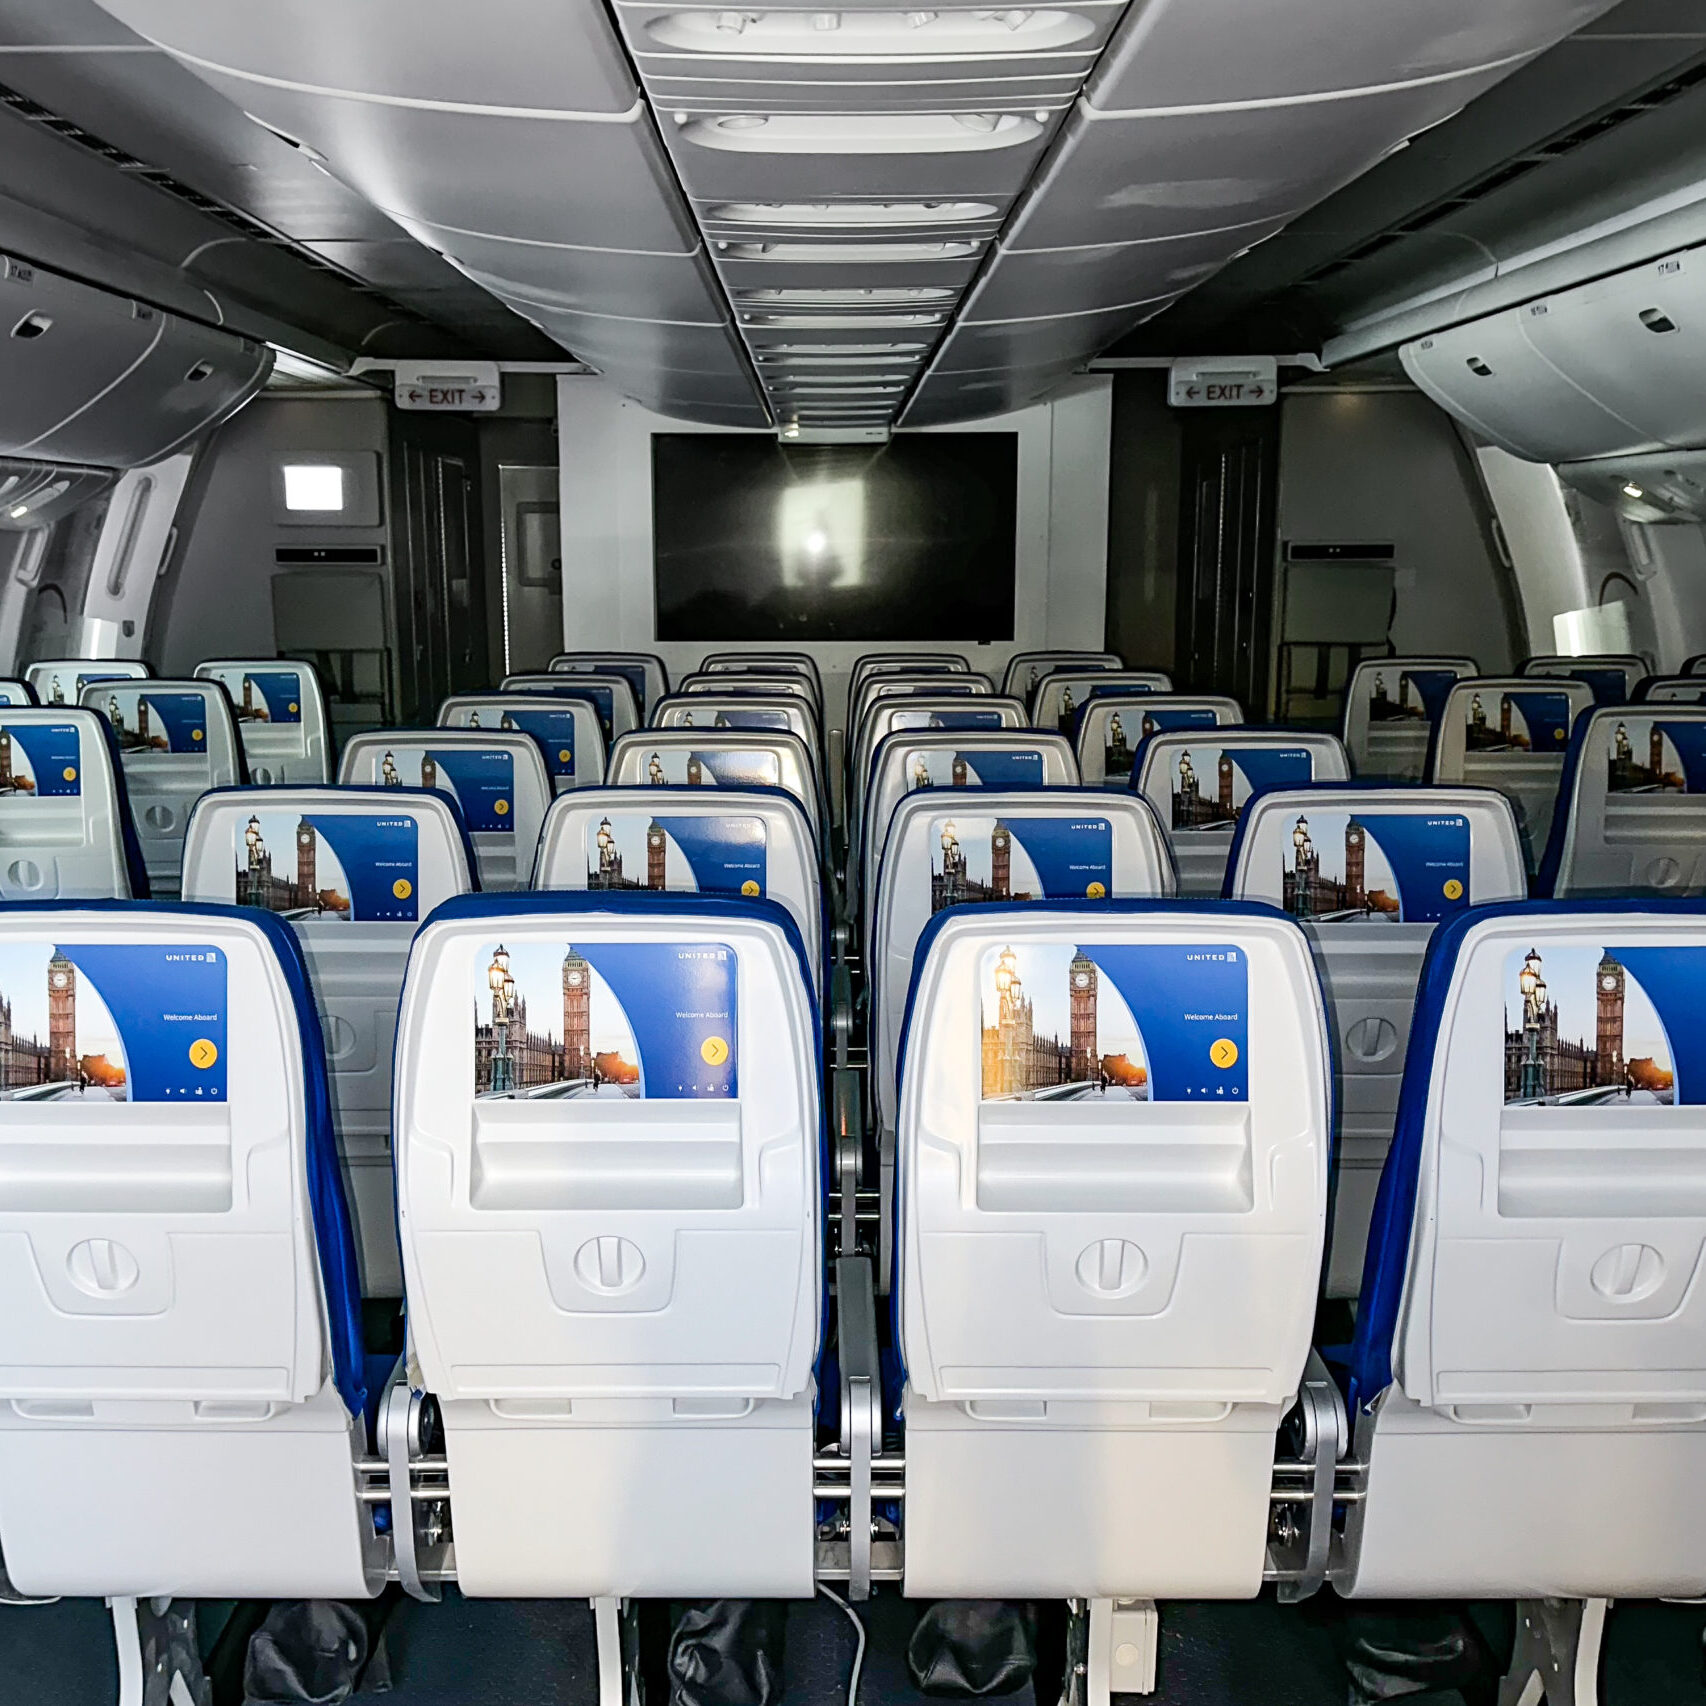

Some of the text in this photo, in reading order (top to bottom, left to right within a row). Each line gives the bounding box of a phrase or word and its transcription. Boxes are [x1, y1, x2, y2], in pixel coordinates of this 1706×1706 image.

[429, 388, 466, 405] EXIT
[1206, 384, 1245, 401] EXIT
[163, 1013, 217, 1021] Welcome Aboard
